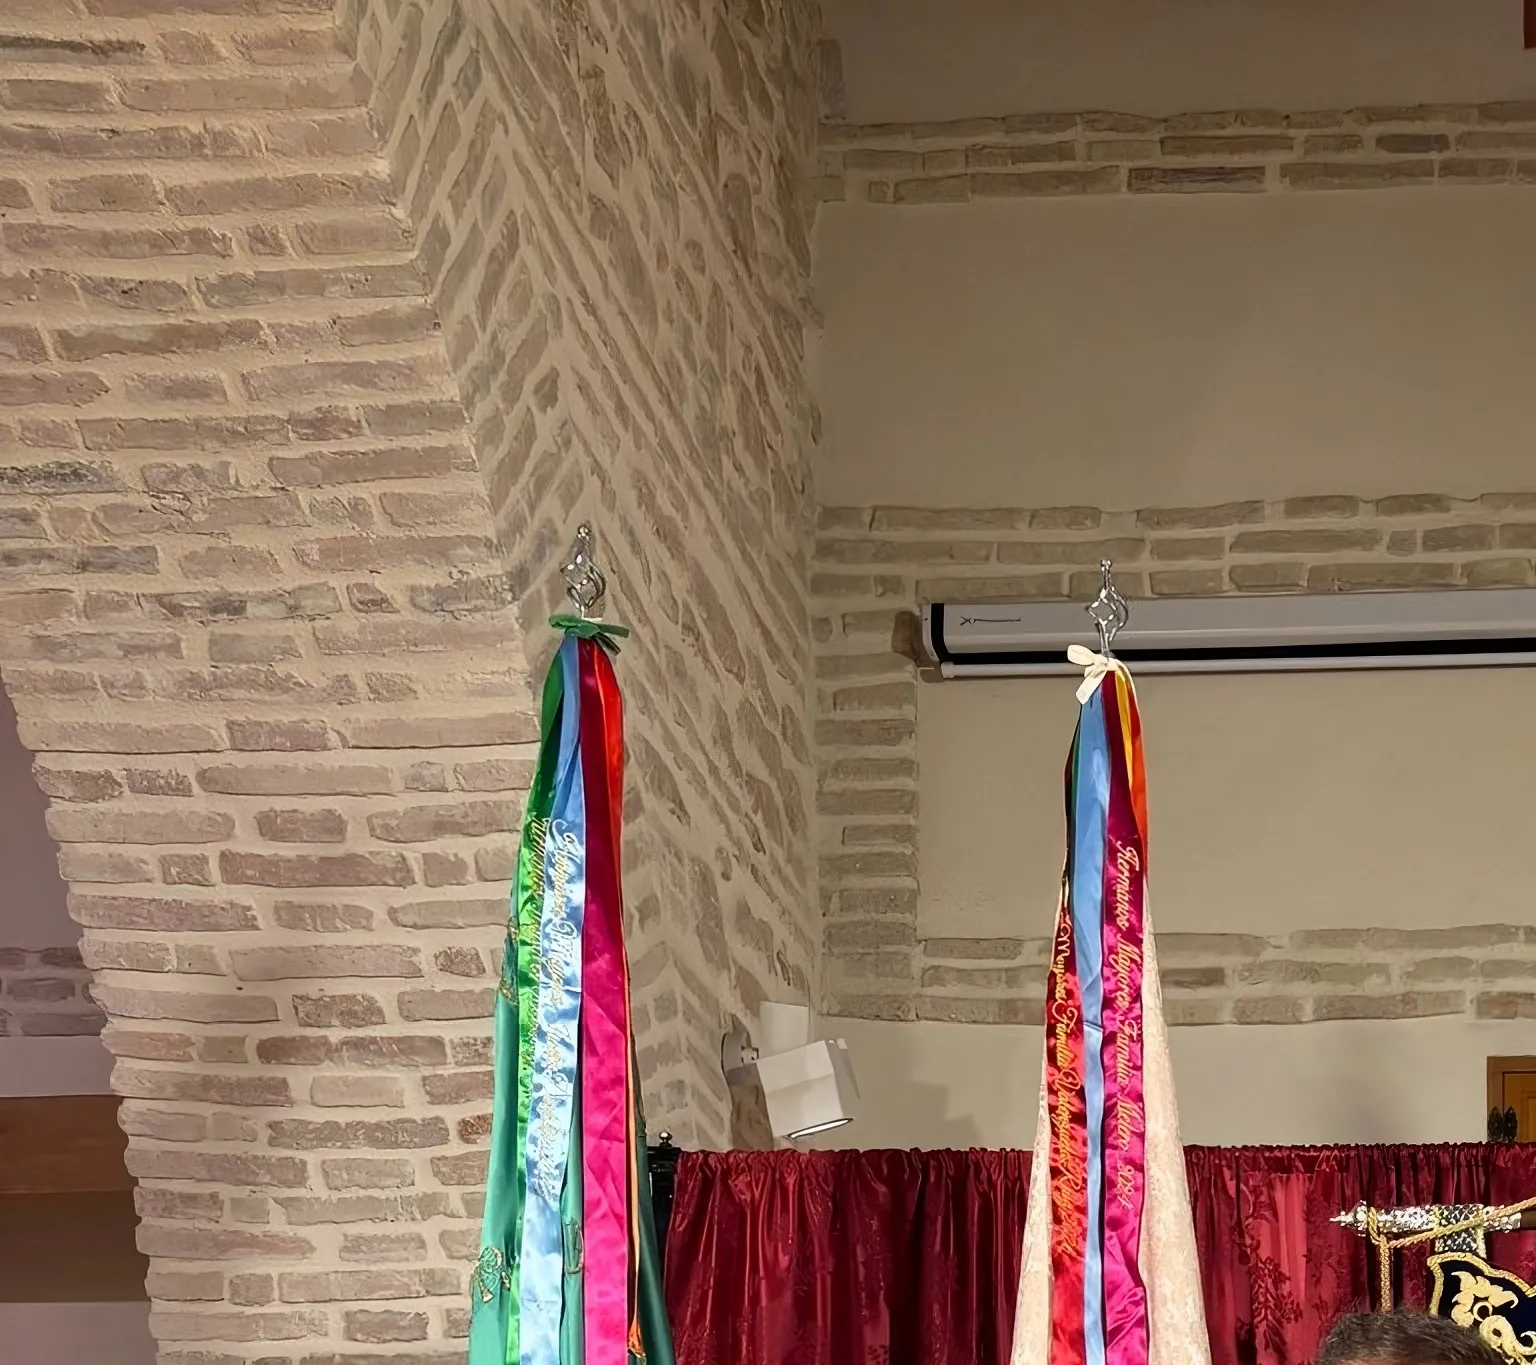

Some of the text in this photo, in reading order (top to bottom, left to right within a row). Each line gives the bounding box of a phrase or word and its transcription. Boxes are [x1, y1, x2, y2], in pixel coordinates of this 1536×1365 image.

[1115, 841, 1140, 930] Hermanos
[1108, 934, 1143, 1009] Mayores
[1053, 1001, 1079, 1068] Familia
[1115, 1020, 1140, 1085] Familia
